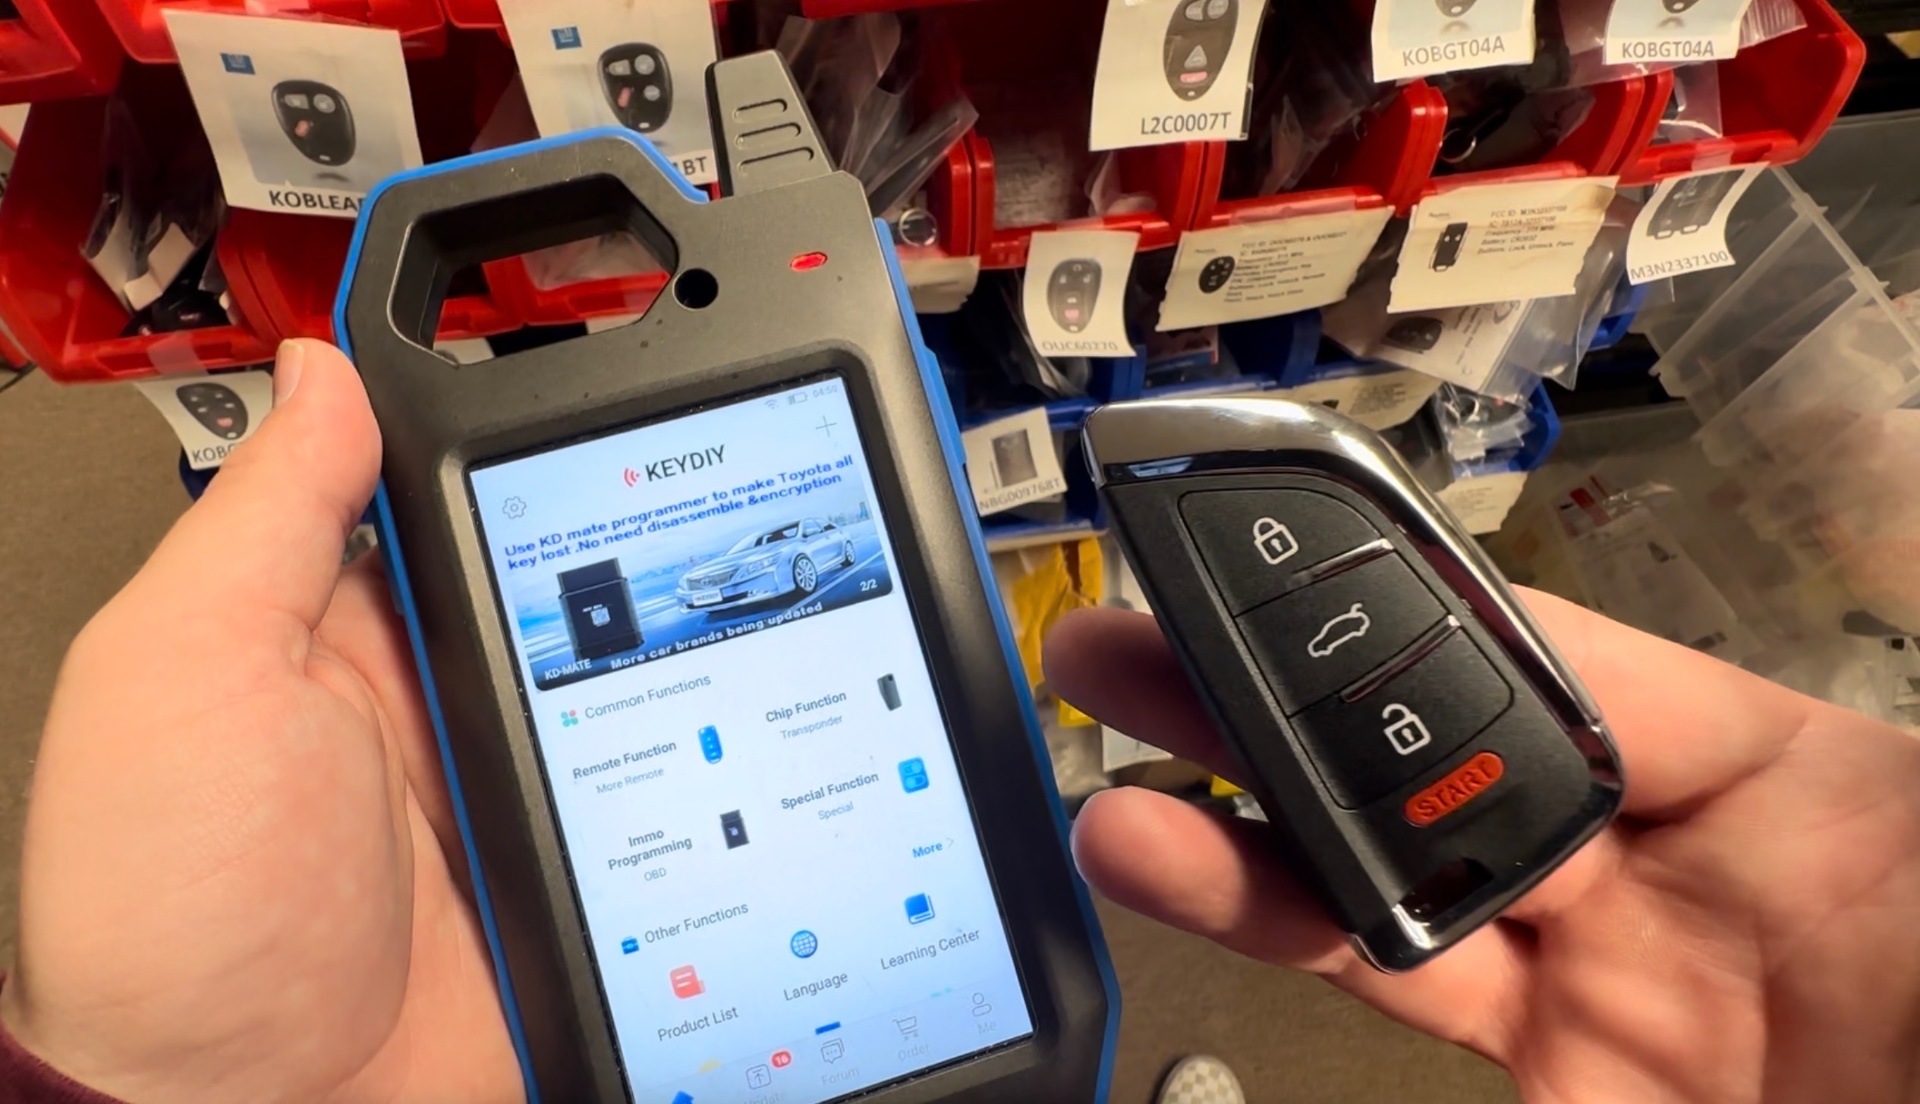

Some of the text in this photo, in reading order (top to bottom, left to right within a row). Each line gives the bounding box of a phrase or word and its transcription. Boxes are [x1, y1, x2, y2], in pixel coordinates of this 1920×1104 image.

[1402, 35, 1506, 67] KOBGT04A
[1621, 40, 1715, 59] KOBGT04A
[1140, 111, 1232, 136] L2C0007T
[268, 189, 367, 212] KOBLEA
[1629, 249, 1729, 281] M3N2337100
[645, 443, 726, 482] KEYDIY
[504, 453, 854, 557] Use KD mate programmer to make Toyota all
[507, 555, 537, 571] key
[541, 545, 571, 562] lost
[604, 525, 644, 545] need
[646, 499, 745, 534] disassemble
[747, 473, 842, 507] &encryption
[859, 577, 878, 592] 2/2
[609, 601, 824, 670] More car brands being updated
[543, 657, 593, 681] KD-MATE
[584, 674, 712, 720] Common Functions
[764, 690, 848, 724] Chip Function
[779, 714, 844, 740] Transponder
[572, 740, 678, 780] Remote Function
[595, 766, 665, 795] More Remote
[780, 770, 880, 811] Special Function
[1416, 759, 1494, 819] START
[817, 800, 855, 821] Special
[607, 836, 693, 871] Programming
[627, 828, 665, 848] Immo
[911, 840, 944, 859] More
[643, 866, 668, 883] OBD
[644, 902, 750, 945] Other Functions
[879, 927, 982, 971] Learning Center
[782, 971, 850, 1002] Language
[656, 1005, 740, 1042] Product List
[774, 1051, 790, 1067] 16
[896, 1042, 930, 1062] Order
[820, 1065, 861, 1088] Forum
